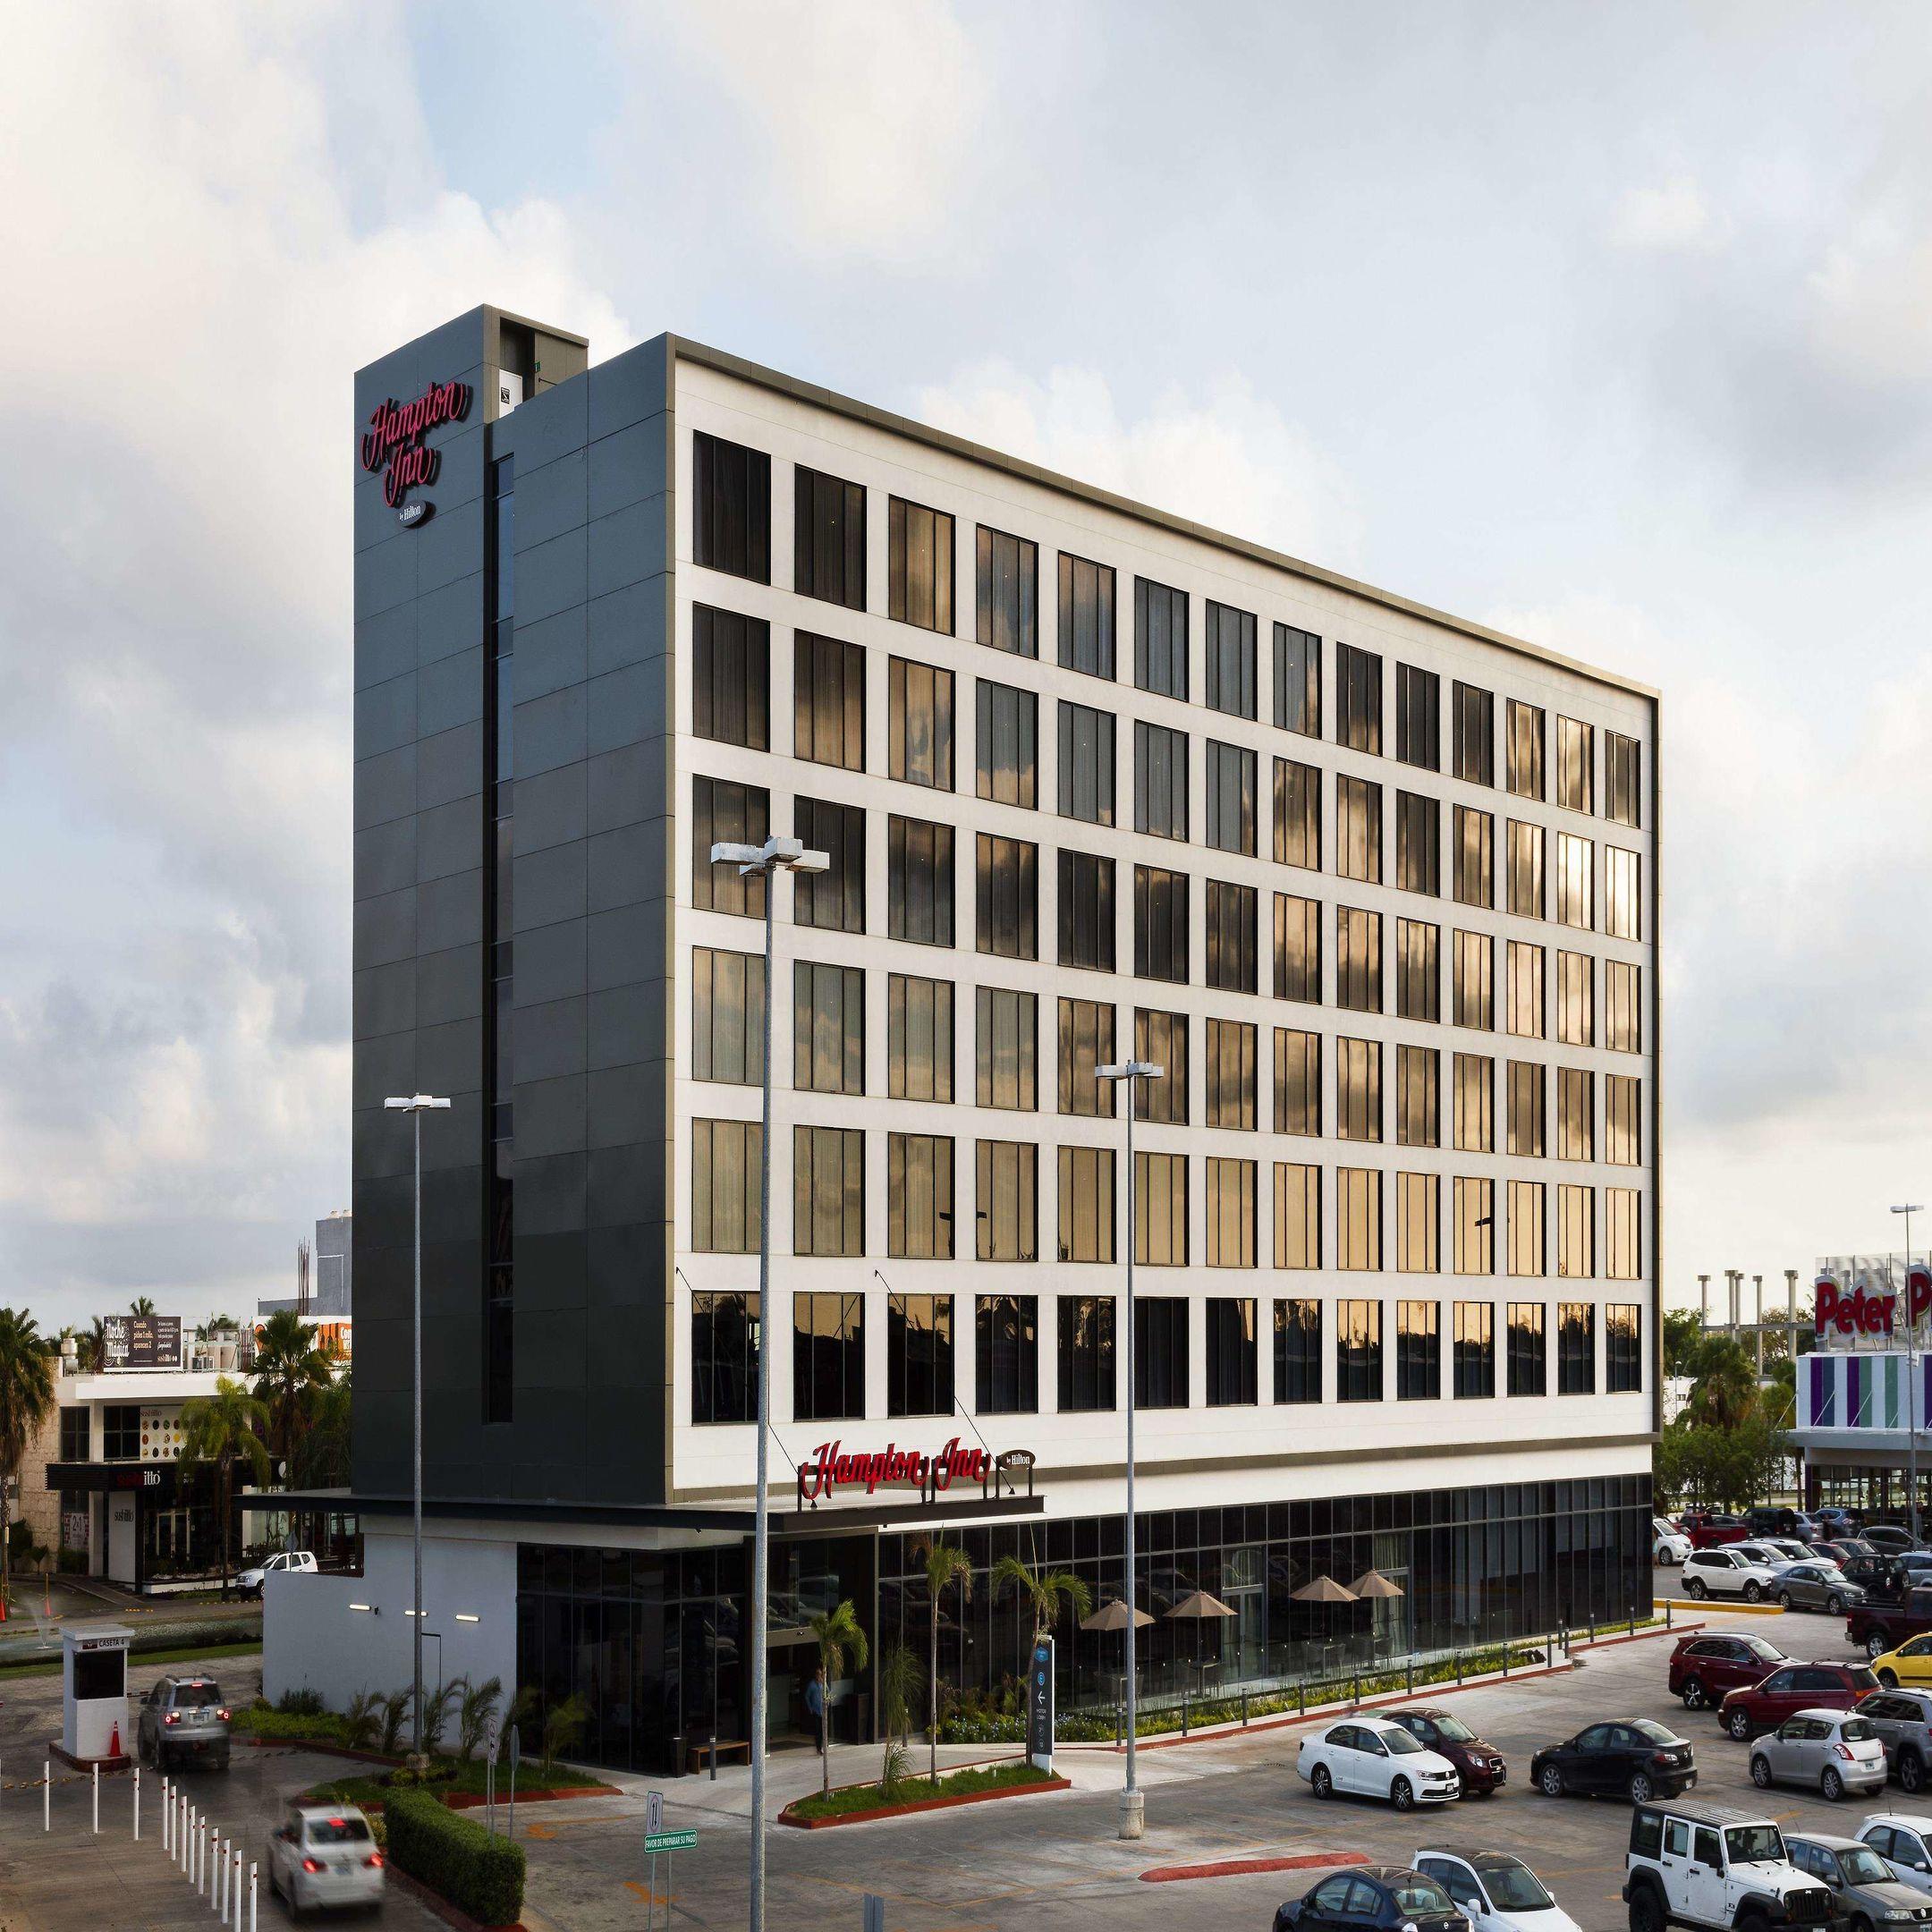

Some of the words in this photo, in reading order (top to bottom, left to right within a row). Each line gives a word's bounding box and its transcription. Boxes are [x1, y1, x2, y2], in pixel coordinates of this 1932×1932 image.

[361, 382, 465, 470] Hampton
[384, 444, 435, 507] Inn
[403, 505, 421, 521] Hilton
[1817, 1282, 1896, 1335] Peter
[800, 1439, 930, 1500] Hampton
[934, 1436, 991, 1492] Inn
[1012, 1453, 1030, 1465] Hilton
[98, 1638, 120, 1648] CASETA
[121, 1638, 124, 1646] 4
[645, 1839, 657, 1849] FAVOR
[657, 1838, 663, 1847] DE
[681, 1835, 686, 1844] SU
[686, 1834, 696, 1843] PAGO
